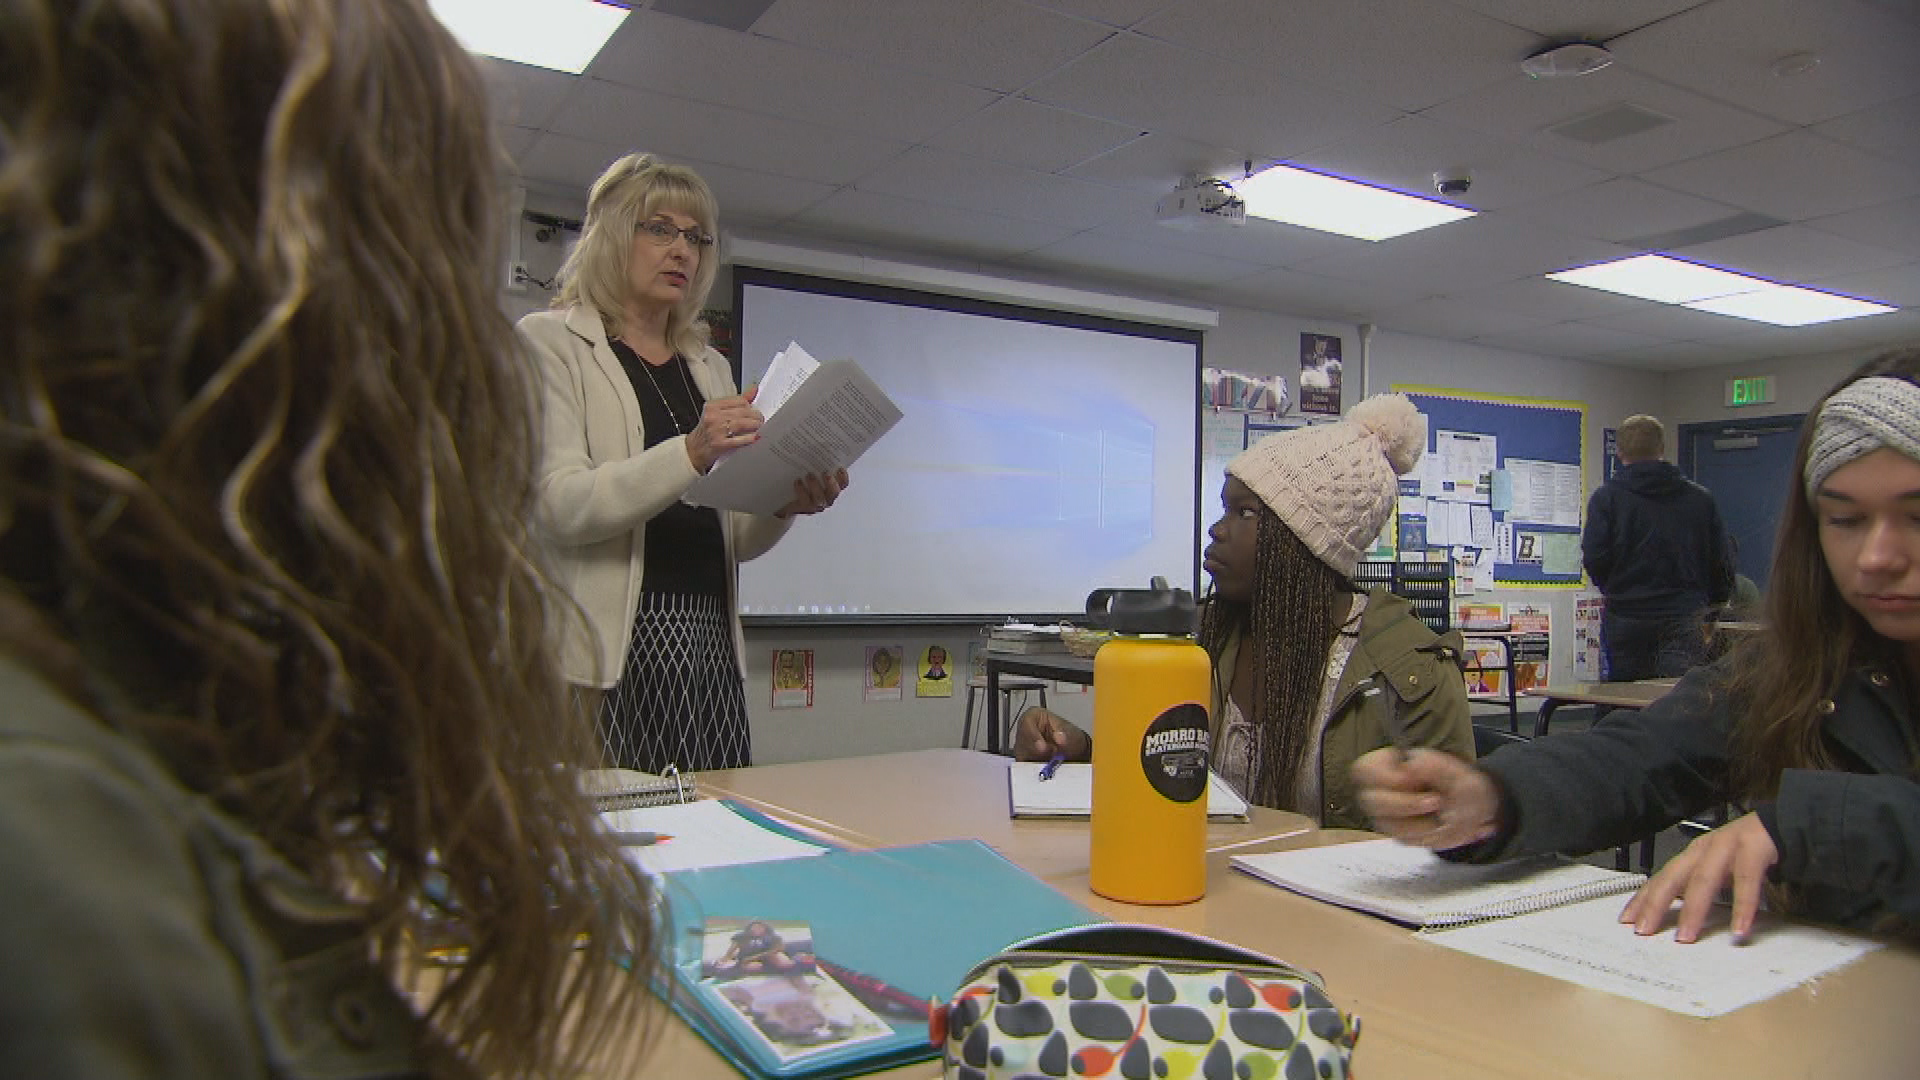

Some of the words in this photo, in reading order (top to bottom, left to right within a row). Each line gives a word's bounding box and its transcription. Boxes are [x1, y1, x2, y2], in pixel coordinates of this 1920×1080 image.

[1733, 379, 1767, 404] EXIT
[1518, 535, 1534, 558] B
[1145, 728, 1196, 748] MORRO
